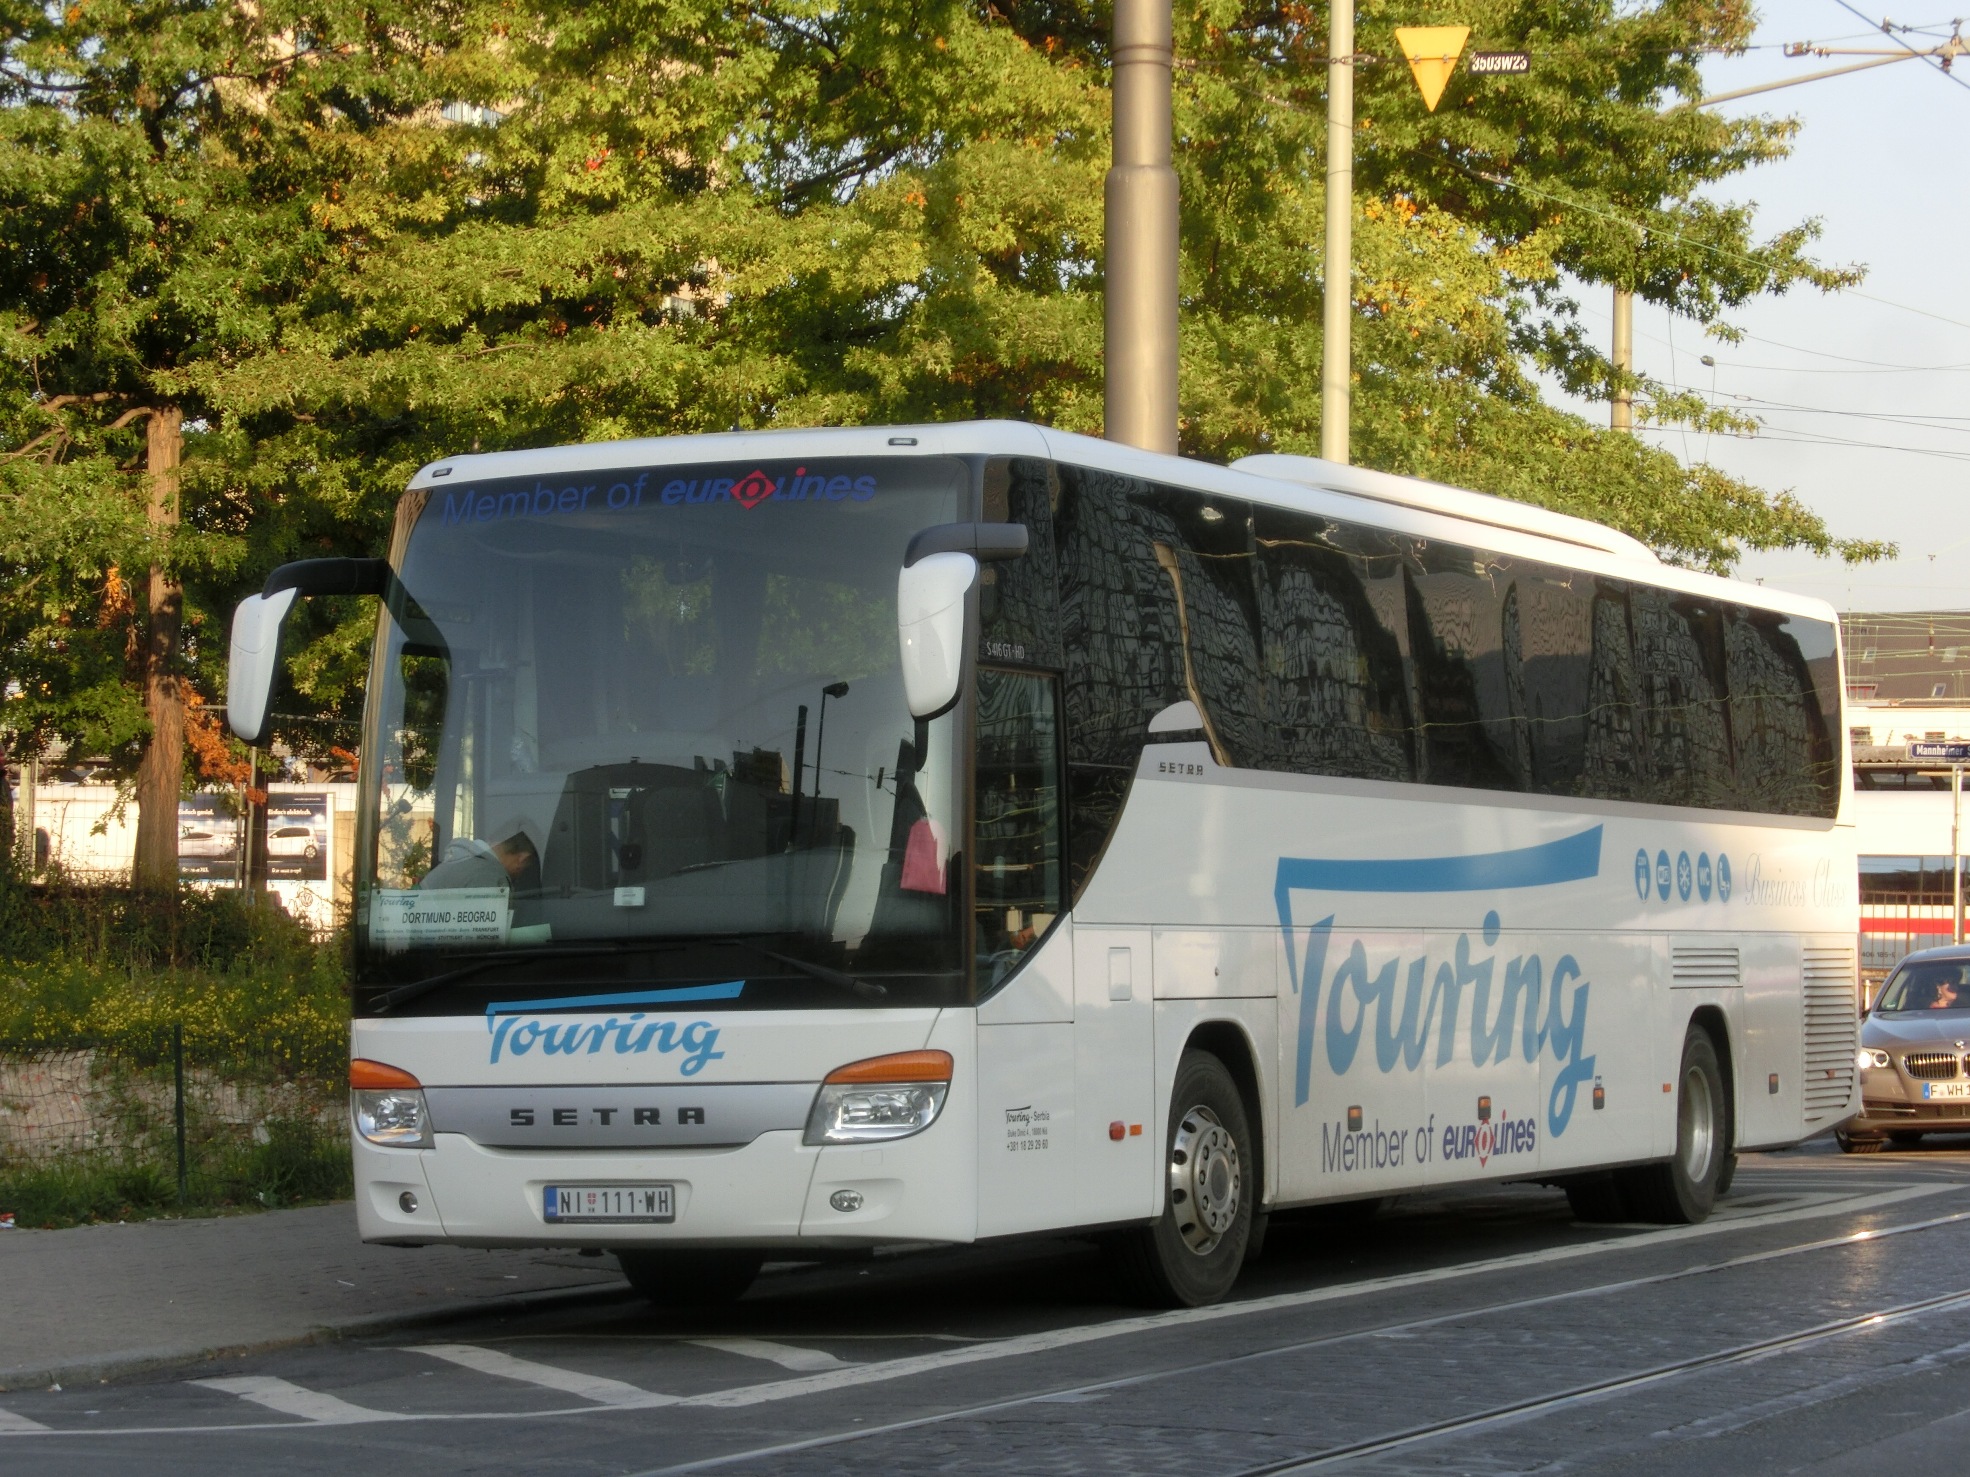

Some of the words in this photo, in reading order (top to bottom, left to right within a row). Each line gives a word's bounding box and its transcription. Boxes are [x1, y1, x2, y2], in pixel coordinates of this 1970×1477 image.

[441, 483, 596, 528] Member
[607, 473, 649, 510] of
[1916, 745, 1964, 756] Mannheimer
[1159, 761, 1203, 776] SETRA
[1698, 866, 1710, 886] WC
[1745, 852, 1807, 907] Business
[379, 894, 419, 910] Touring
[402, 911, 451, 924] DORTMUND
[457, 910, 497, 923] BEOGRAD
[1273, 823, 1603, 1138] Touring
[485, 979, 745, 1077] Touring
[1930, 1084, 1938, 1096] F
[1947, 1084, 1963, 1096] WH
[511, 1107, 705, 1126] SETRA
[1033, 1110, 1050, 1121] Serbia
[1322, 1118, 1408, 1173] Member
[1415, 1113, 1435, 1164] of
[560, 1191, 581, 1213] NI
